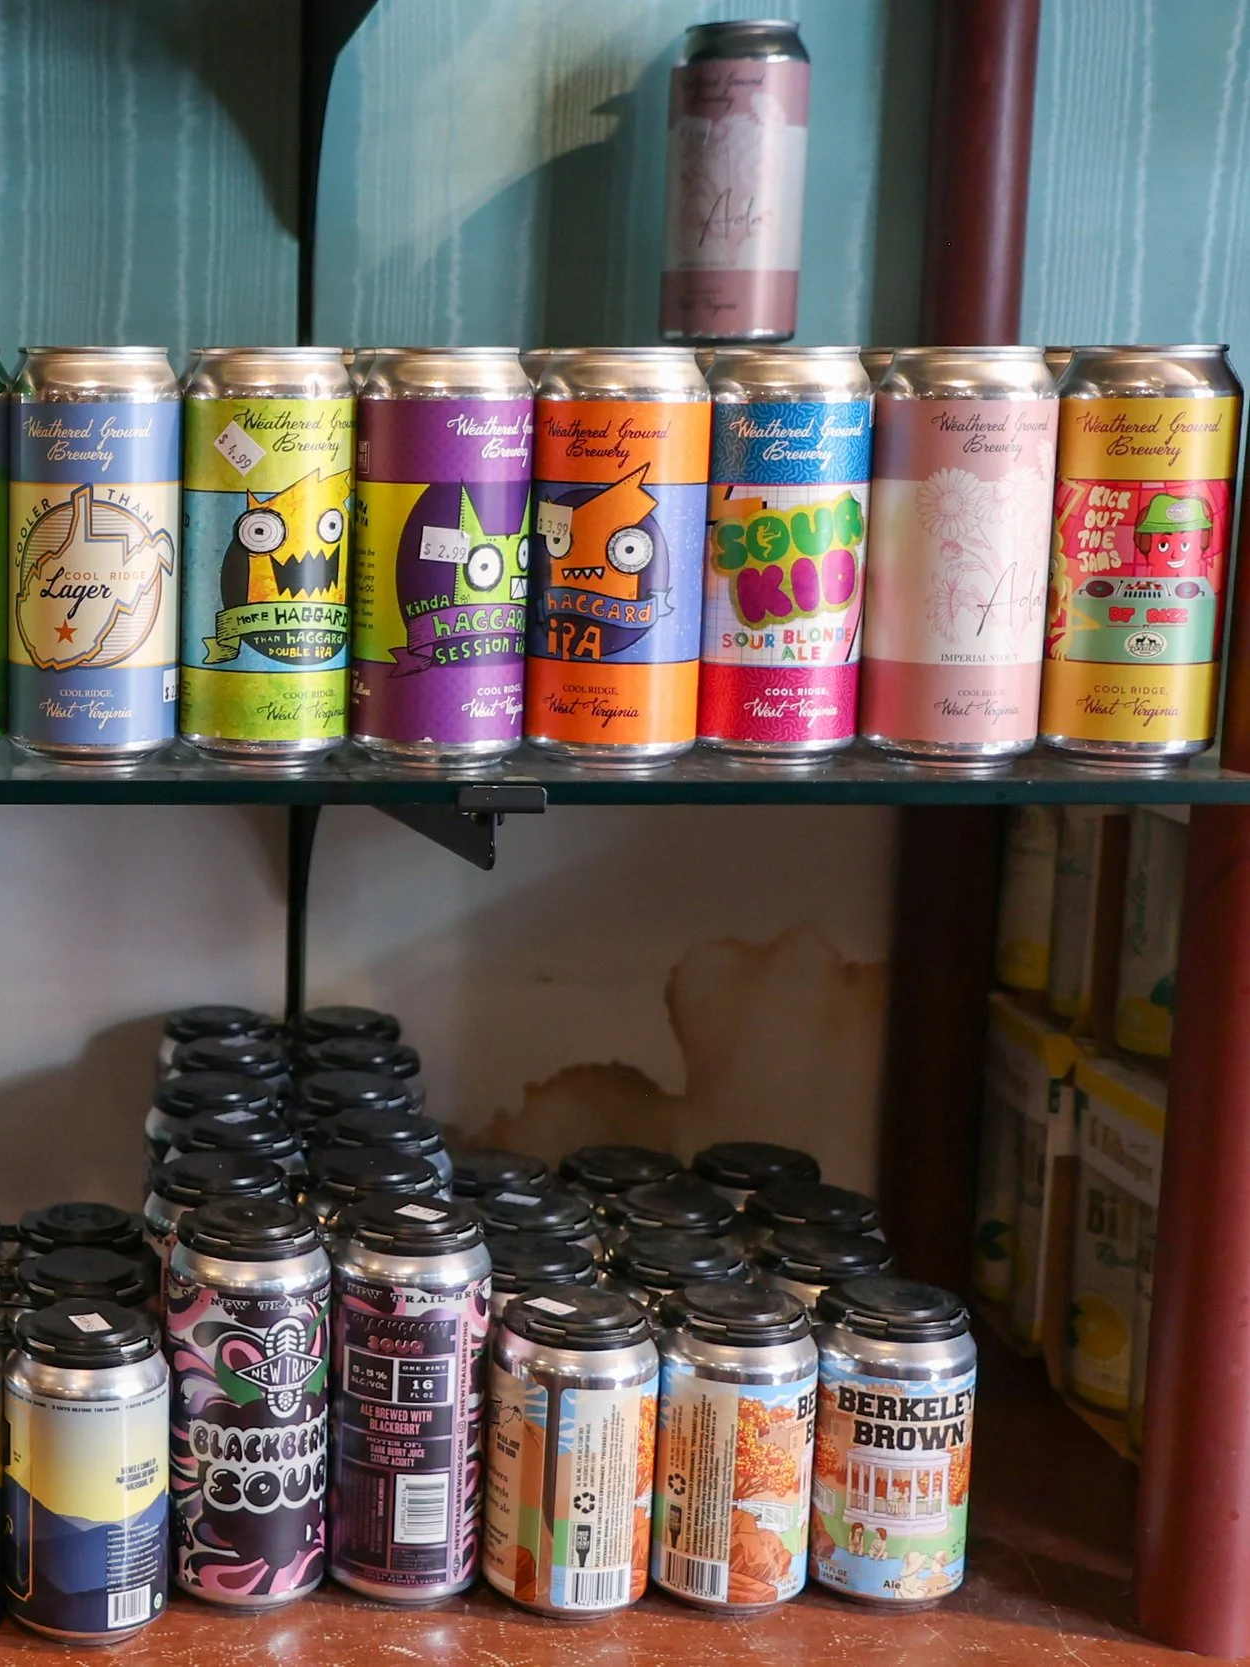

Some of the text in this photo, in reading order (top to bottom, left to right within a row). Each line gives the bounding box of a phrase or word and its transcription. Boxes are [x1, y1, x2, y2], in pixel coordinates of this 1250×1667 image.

[233, 408, 323, 430] Weathered
[446, 414, 519, 436] Weathered
[730, 416, 865, 450] Weathered Ground
[931, 411, 1050, 442] Weathered Ground
[1076, 411, 1222, 445] Weathered Ground
[23, 415, 152, 452] Weathered Ground
[218, 434, 228, 445] $
[272, 432, 341, 461] Brewery
[543, 417, 612, 438] Weathered
[615, 418, 672, 450] Ground
[963, 433, 1023, 462] Brewery
[47, 440, 114, 471] Brewery
[481, 438, 530, 468] Brewery
[566, 439, 631, 468] Brewery
[763, 440, 833, 470] Brewery
[1106, 434, 1183, 466] Brewery
[1089, 486, 1131, 510] KICK
[14, 489, 154, 568] COOLER THAN
[547, 521, 568, 537] 3.99
[1084, 509, 1124, 529] OUT
[716, 498, 863, 570] SOUR
[1077, 530, 1116, 550] THE
[423, 543, 467, 560] $ 2.99
[1077, 551, 1122, 573] JAMS
[64, 571, 146, 582] COOL RIDGE
[737, 549, 856, 623] KID
[39, 567, 113, 619] Lager
[977, 561, 1043, 636] Ada
[269, 647, 310, 657] DOUBLE
[722, 627, 851, 649] SOUR BLONDE
[782, 646, 822, 660] ALE
[941, 653, 988, 662] IMPERIAL
[39, 700, 136, 728] West Virginia
[257, 702, 301, 720] West
[461, 699, 501, 718] West
[543, 694, 640, 728] West Virginia
[744, 699, 838, 728] West Virginia
[934, 698, 1019, 725] West Virginia
[1077, 695, 1179, 727] West Virginia
[211, 1297, 307, 1311] NEW TRAIL
[347, 1283, 446, 1303] NEW TRAIL
[367, 1335, 426, 1356] SOUR
[251, 1356, 314, 1384] NEW TRAIL
[352, 1364, 388, 1381] 5.5%
[369, 1418, 421, 1435] BLACKBERRY
[375, 1407, 433, 1423] BREWED WITH
[194, 1418, 326, 1463] BLACKBERR
[853, 1419, 965, 1451] BROWN
[370, 1444, 406, 1457] DARK BERRY
[209, 1453, 326, 1507] SOUR
[454, 1439, 464, 1550] NEWTRAILBREWING.COM
